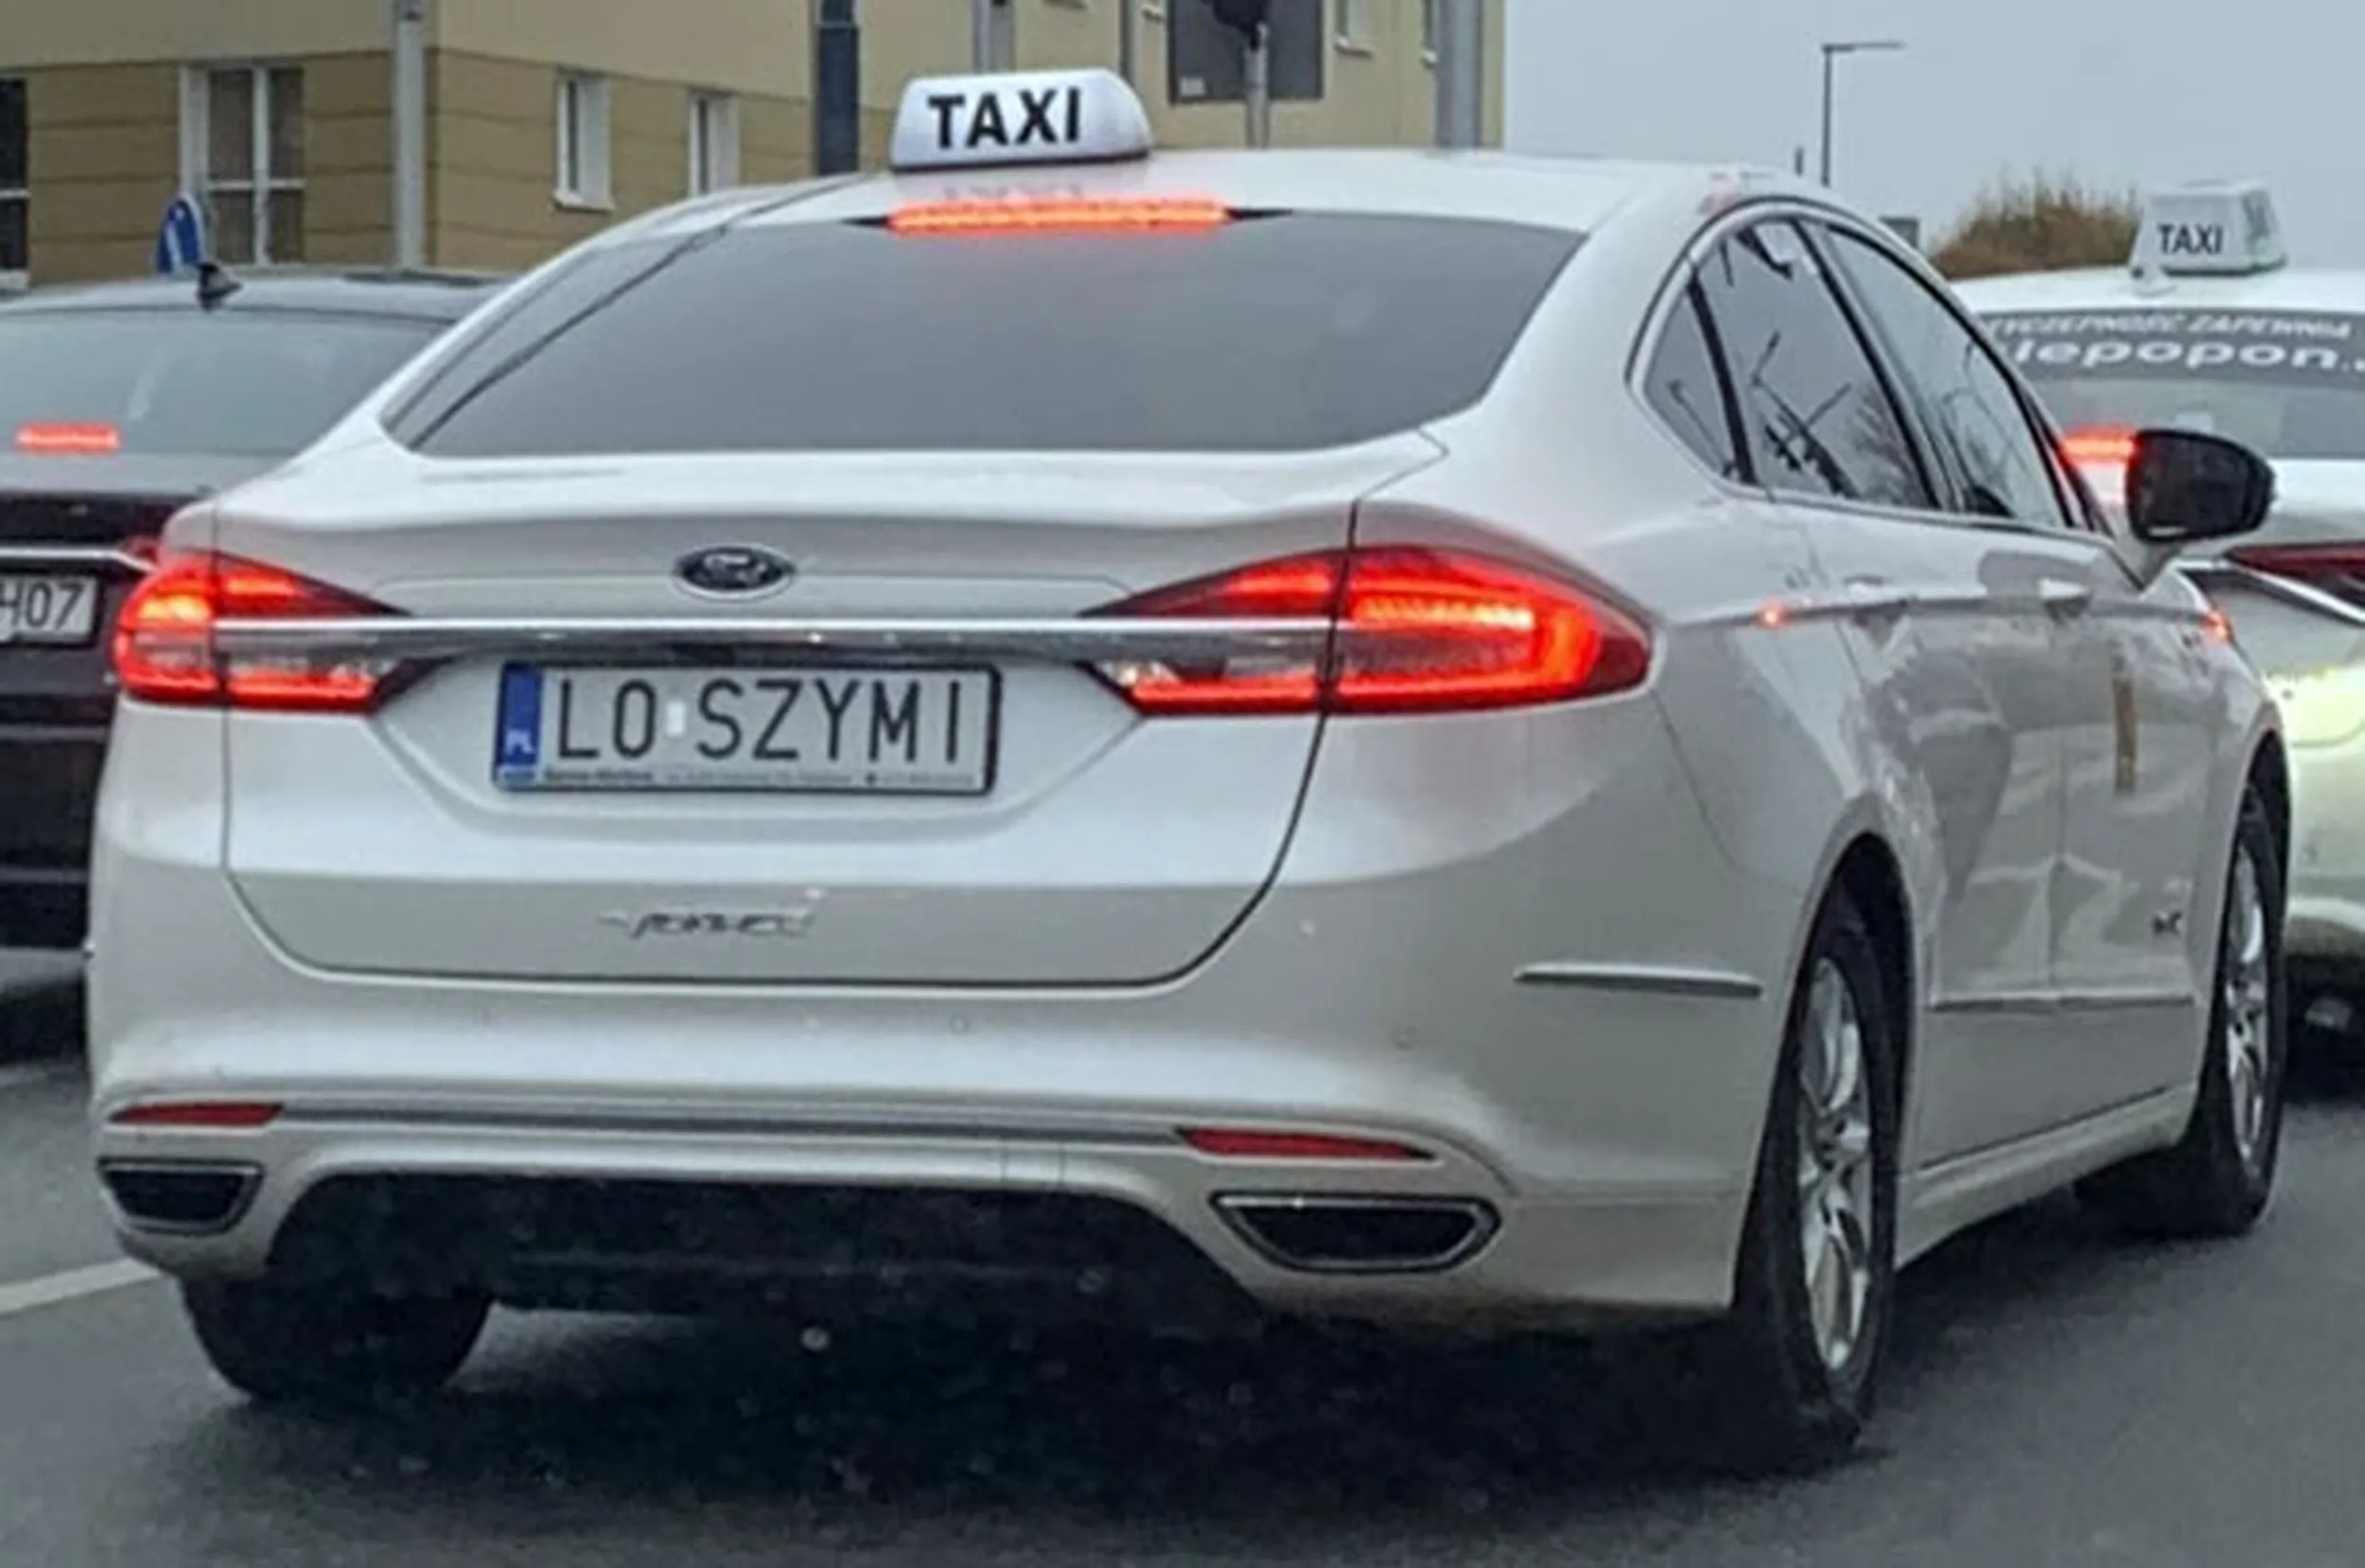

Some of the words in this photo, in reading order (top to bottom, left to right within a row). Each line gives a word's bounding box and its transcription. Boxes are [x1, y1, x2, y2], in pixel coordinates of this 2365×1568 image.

[928, 88, 1081, 149] TAXI
[2156, 222, 2223, 255] TAXI
[696, 678, 960, 764] SZYMI
